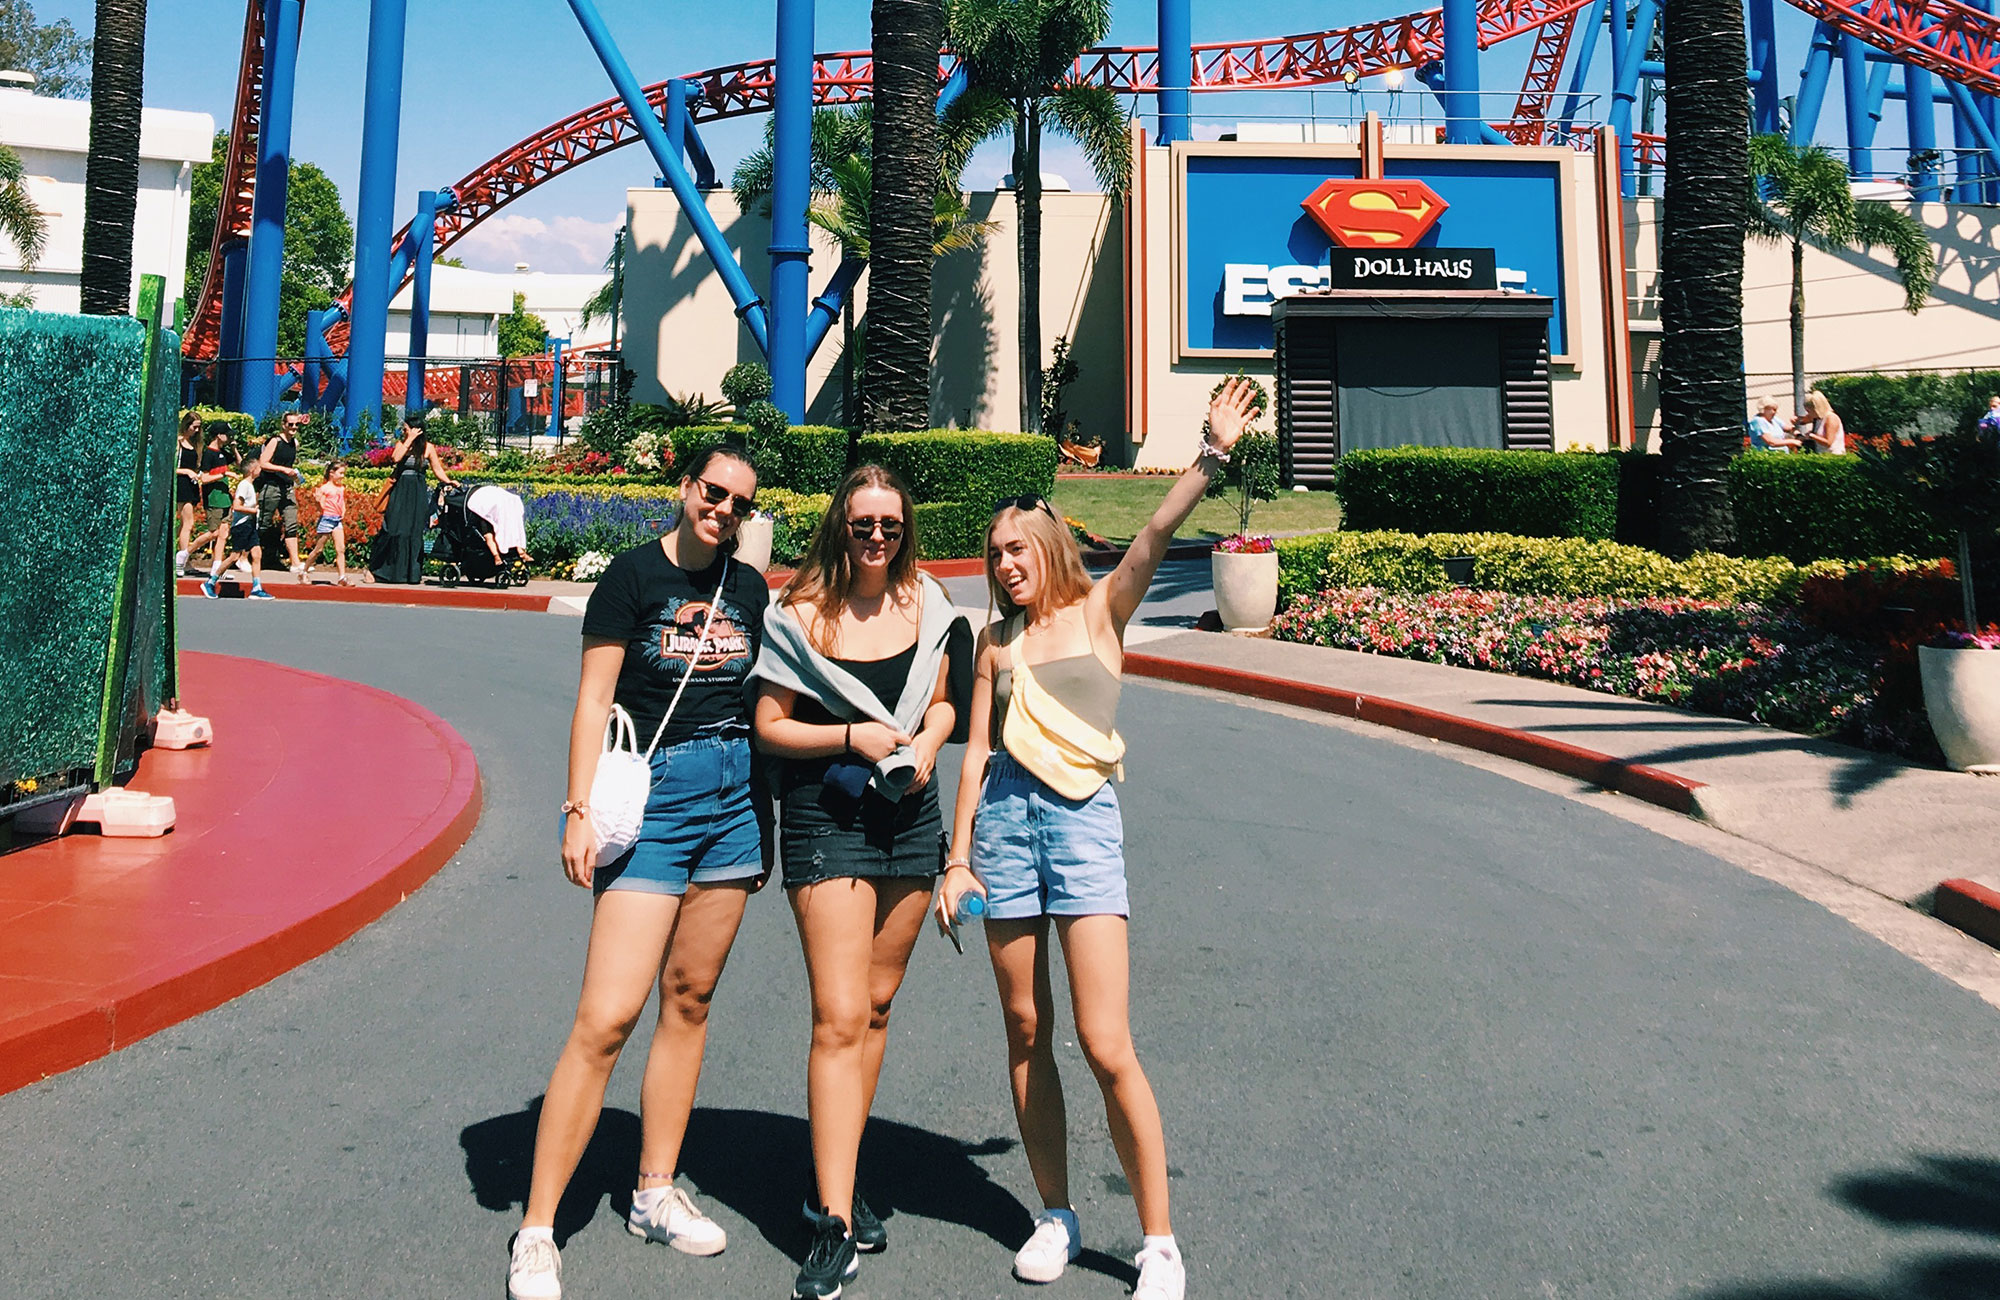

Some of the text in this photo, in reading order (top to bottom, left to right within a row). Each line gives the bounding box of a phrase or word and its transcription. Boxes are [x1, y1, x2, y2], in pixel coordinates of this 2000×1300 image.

[1354, 257, 1473, 279] DOLL HAUS
[713, 635, 745, 654] PARK
